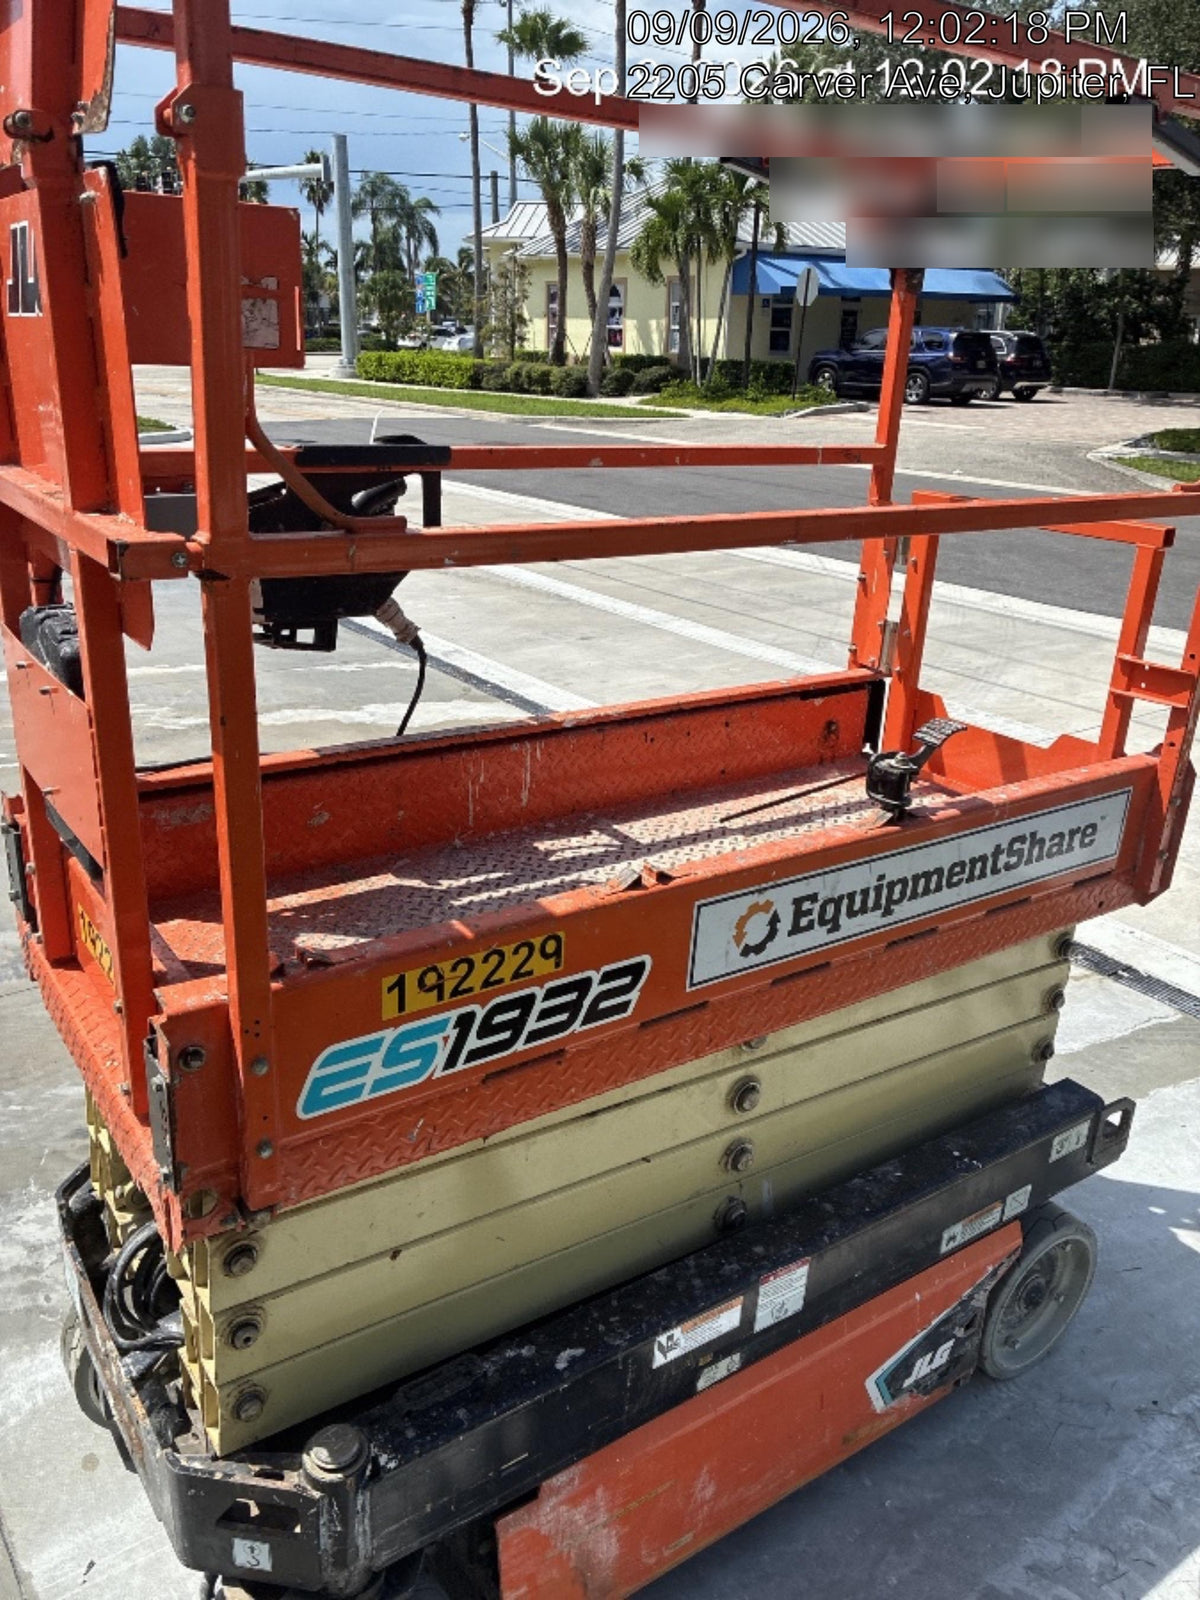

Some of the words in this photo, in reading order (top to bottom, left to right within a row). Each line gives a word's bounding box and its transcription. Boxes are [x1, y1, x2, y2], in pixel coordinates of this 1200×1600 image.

[787, 820, 1098, 938] EquipmentShare
[80, 909, 114, 985] 1922
[386, 932, 564, 1015] 192229
[297, 954, 652, 1119] ES1932
